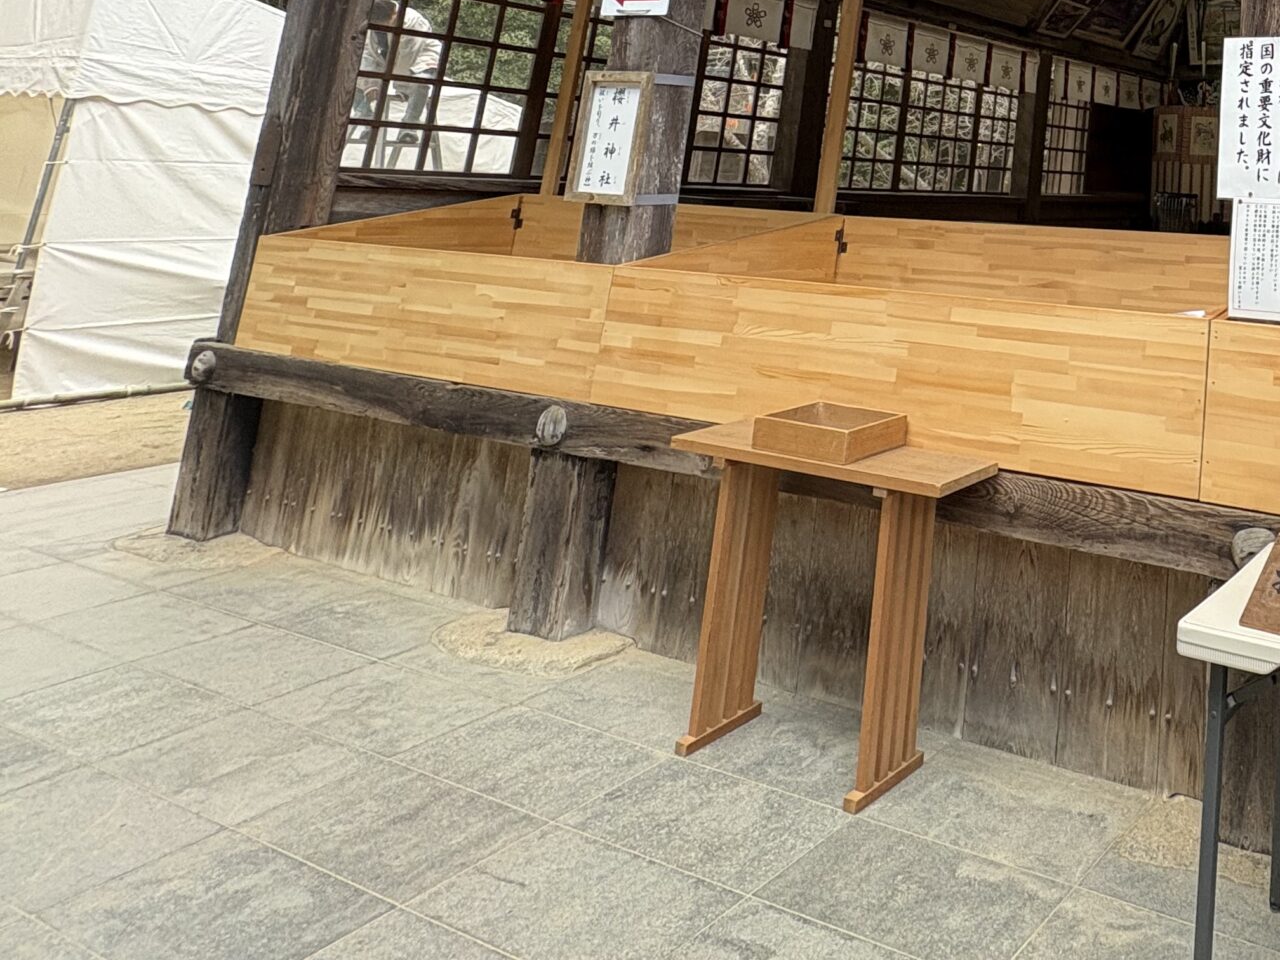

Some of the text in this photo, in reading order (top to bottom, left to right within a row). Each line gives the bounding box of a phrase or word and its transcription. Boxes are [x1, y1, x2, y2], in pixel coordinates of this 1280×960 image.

[598, 87, 627, 186] 櫻井神社
[1236, 42, 1254, 171] 指定されました。
[1256, 43, 1275, 182] 国の重要文化財に
